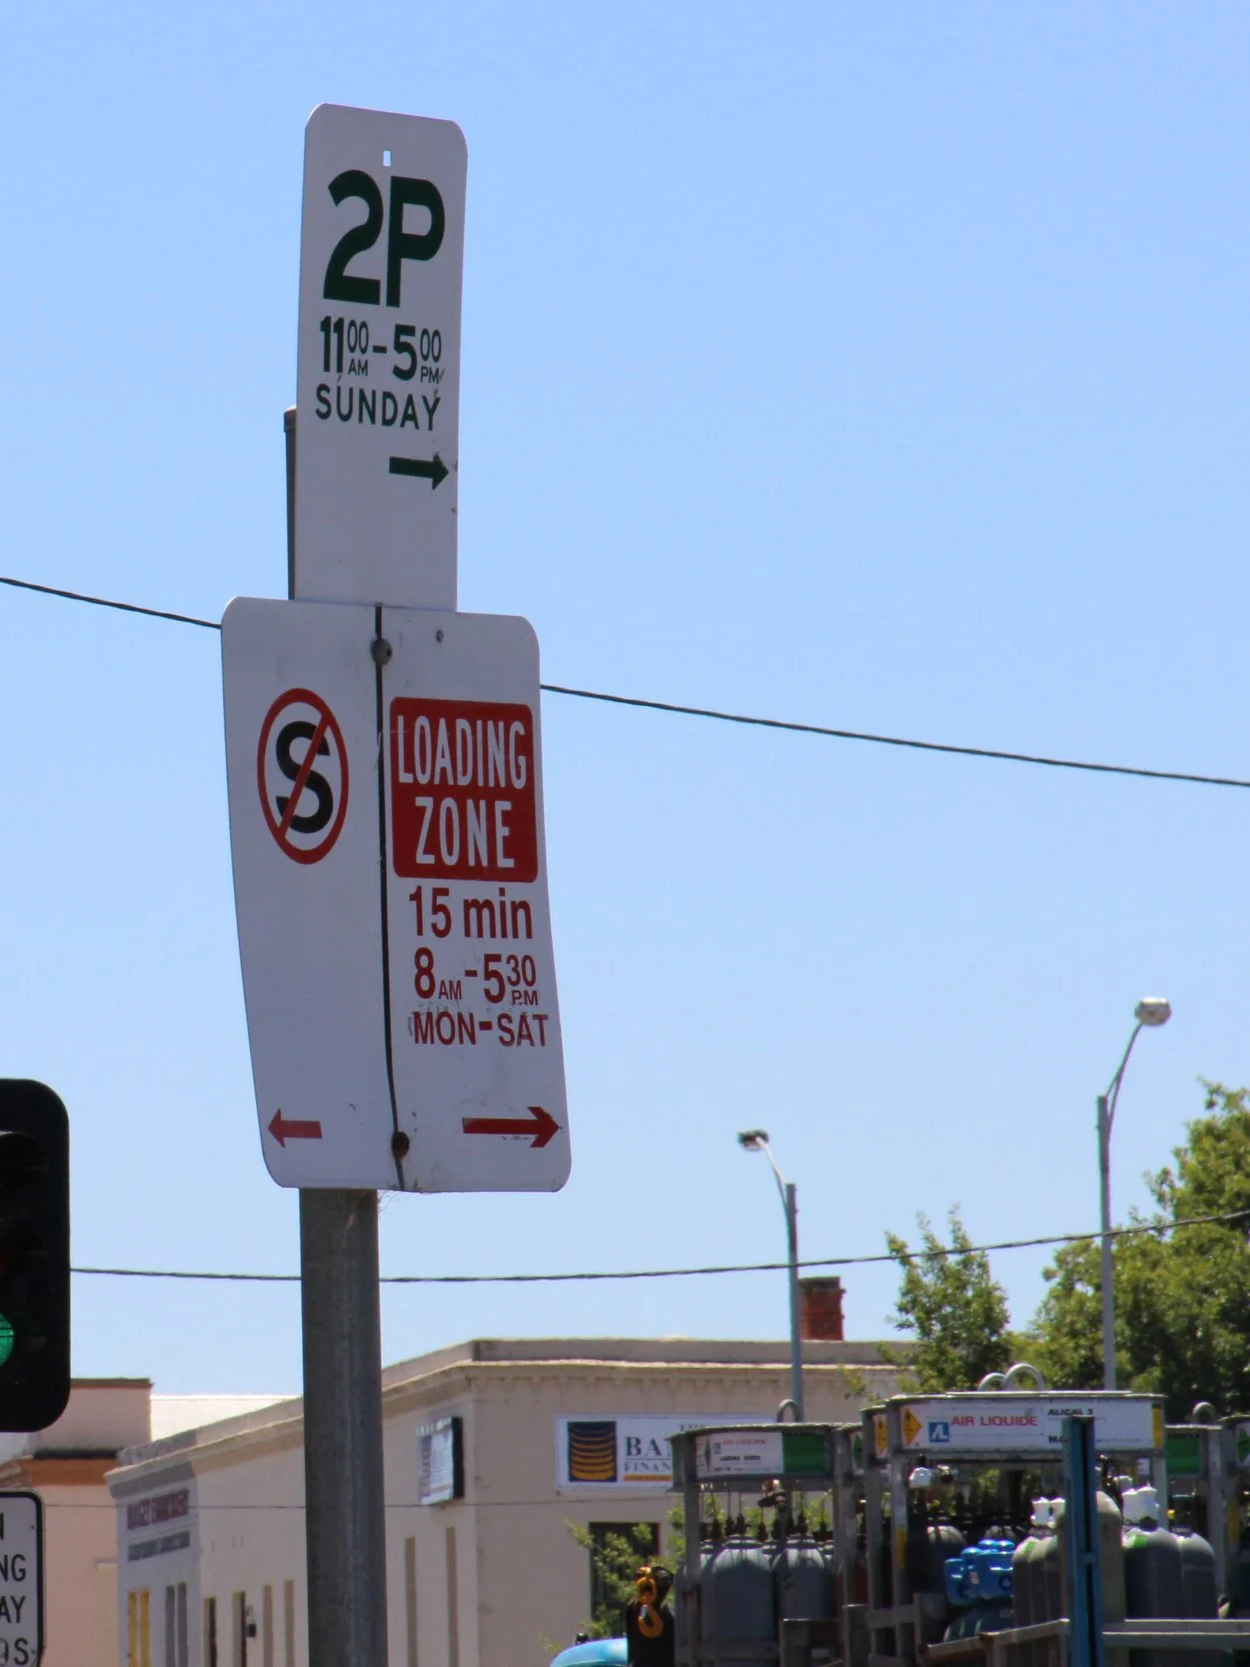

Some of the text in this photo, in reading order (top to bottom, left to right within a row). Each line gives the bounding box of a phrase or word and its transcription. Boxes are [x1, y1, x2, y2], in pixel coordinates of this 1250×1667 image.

[323, 169, 445, 308] 2P
[315, 382, 441, 431] SUNDAY
[398, 715, 527, 789] LOADING
[415, 796, 515, 868] ZONE
[409, 885, 533, 940] 15 min
[951, 1416, 1038, 1426] AIR LIQUIDE
